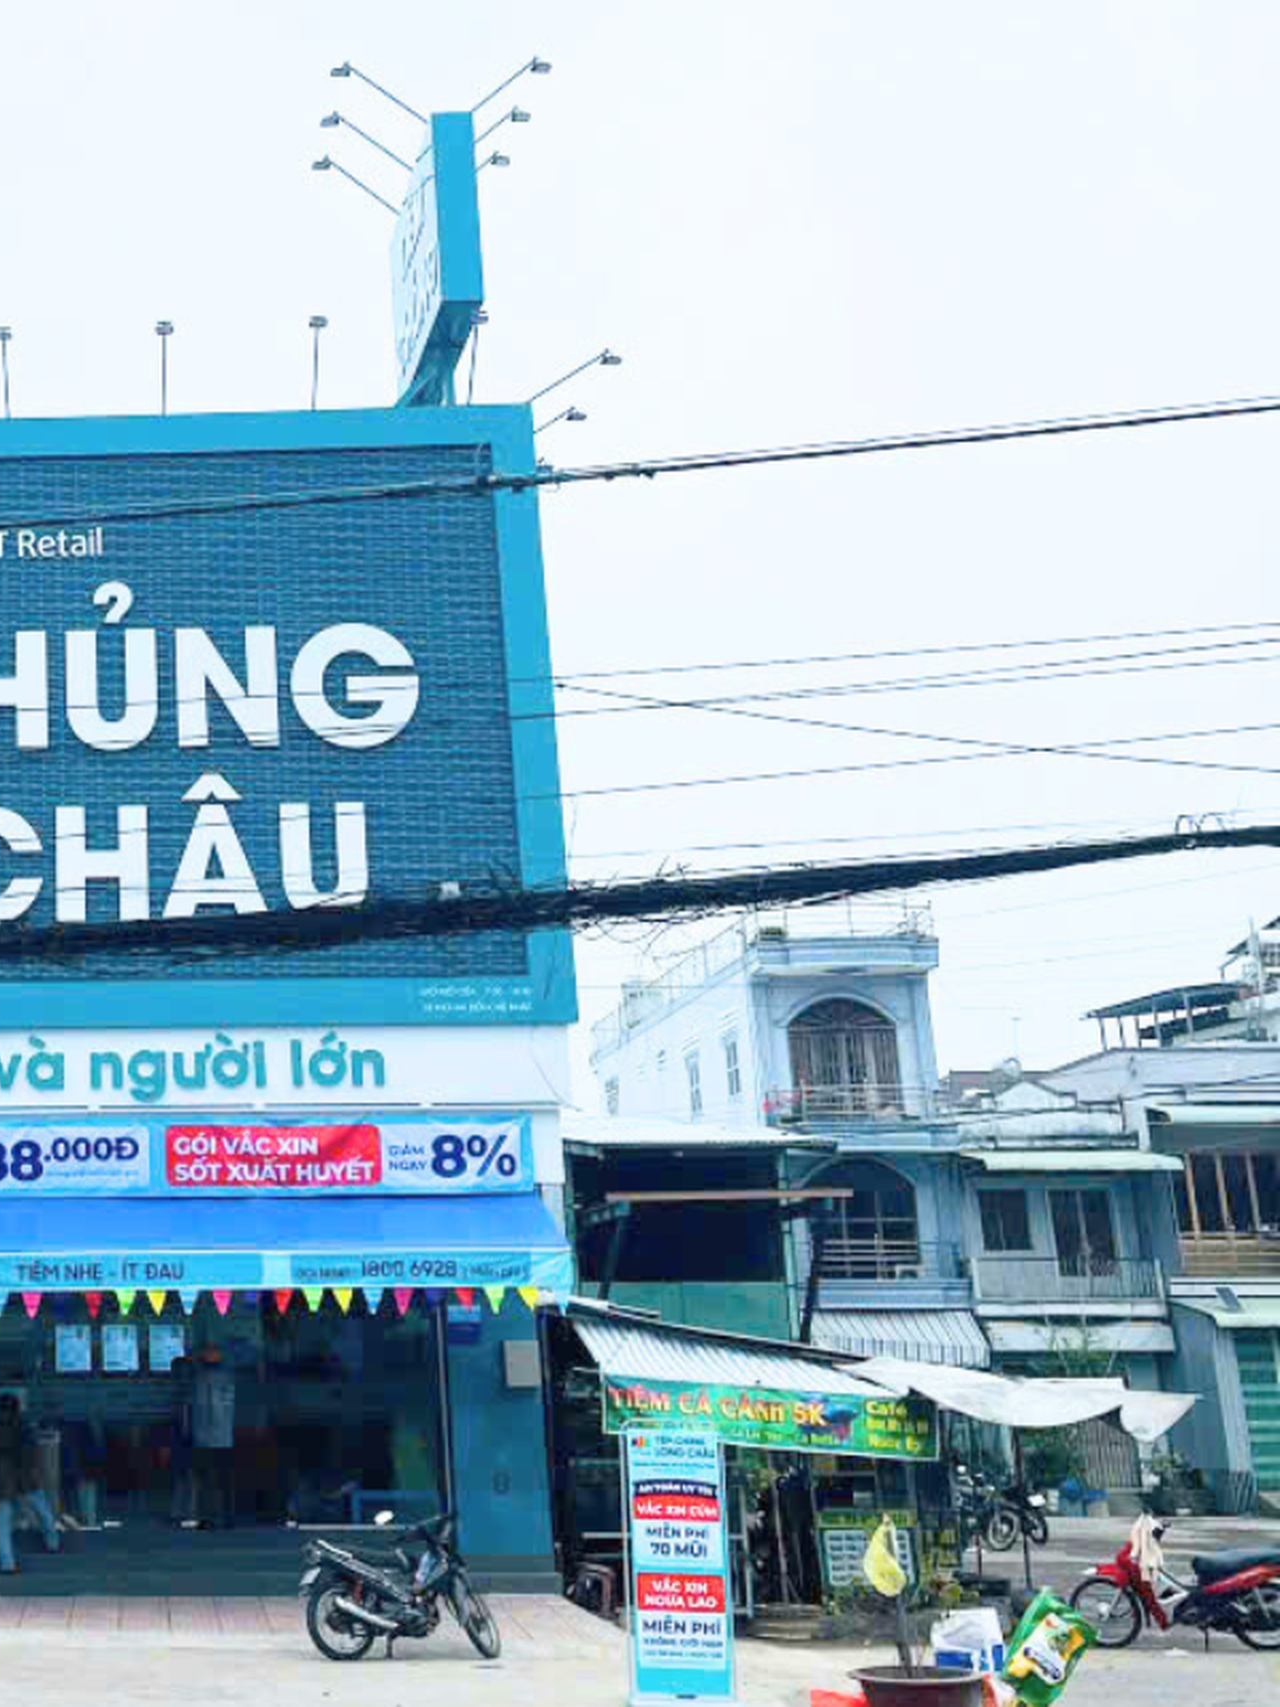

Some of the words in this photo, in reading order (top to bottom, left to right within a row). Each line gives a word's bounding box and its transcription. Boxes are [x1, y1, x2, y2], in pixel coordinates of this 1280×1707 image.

[18, 527, 104, 559] Retail
[89, 1033, 268, 1103] người
[289, 1030, 386, 1088] lớn
[174, 1133, 217, 1156] GÓI
[276, 1136, 318, 1156] XIN
[430, 1133, 517, 1179] 8%
[173, 1157, 221, 1182] SỐT
[226, 1157, 292, 1182] XUẤT
[296, 1156, 375, 1182] HUYẾT
[16, 1260, 61, 1282] TIÊM
[362, 1260, 406, 1278] 1800
[410, 1260, 458, 1278] 6928
